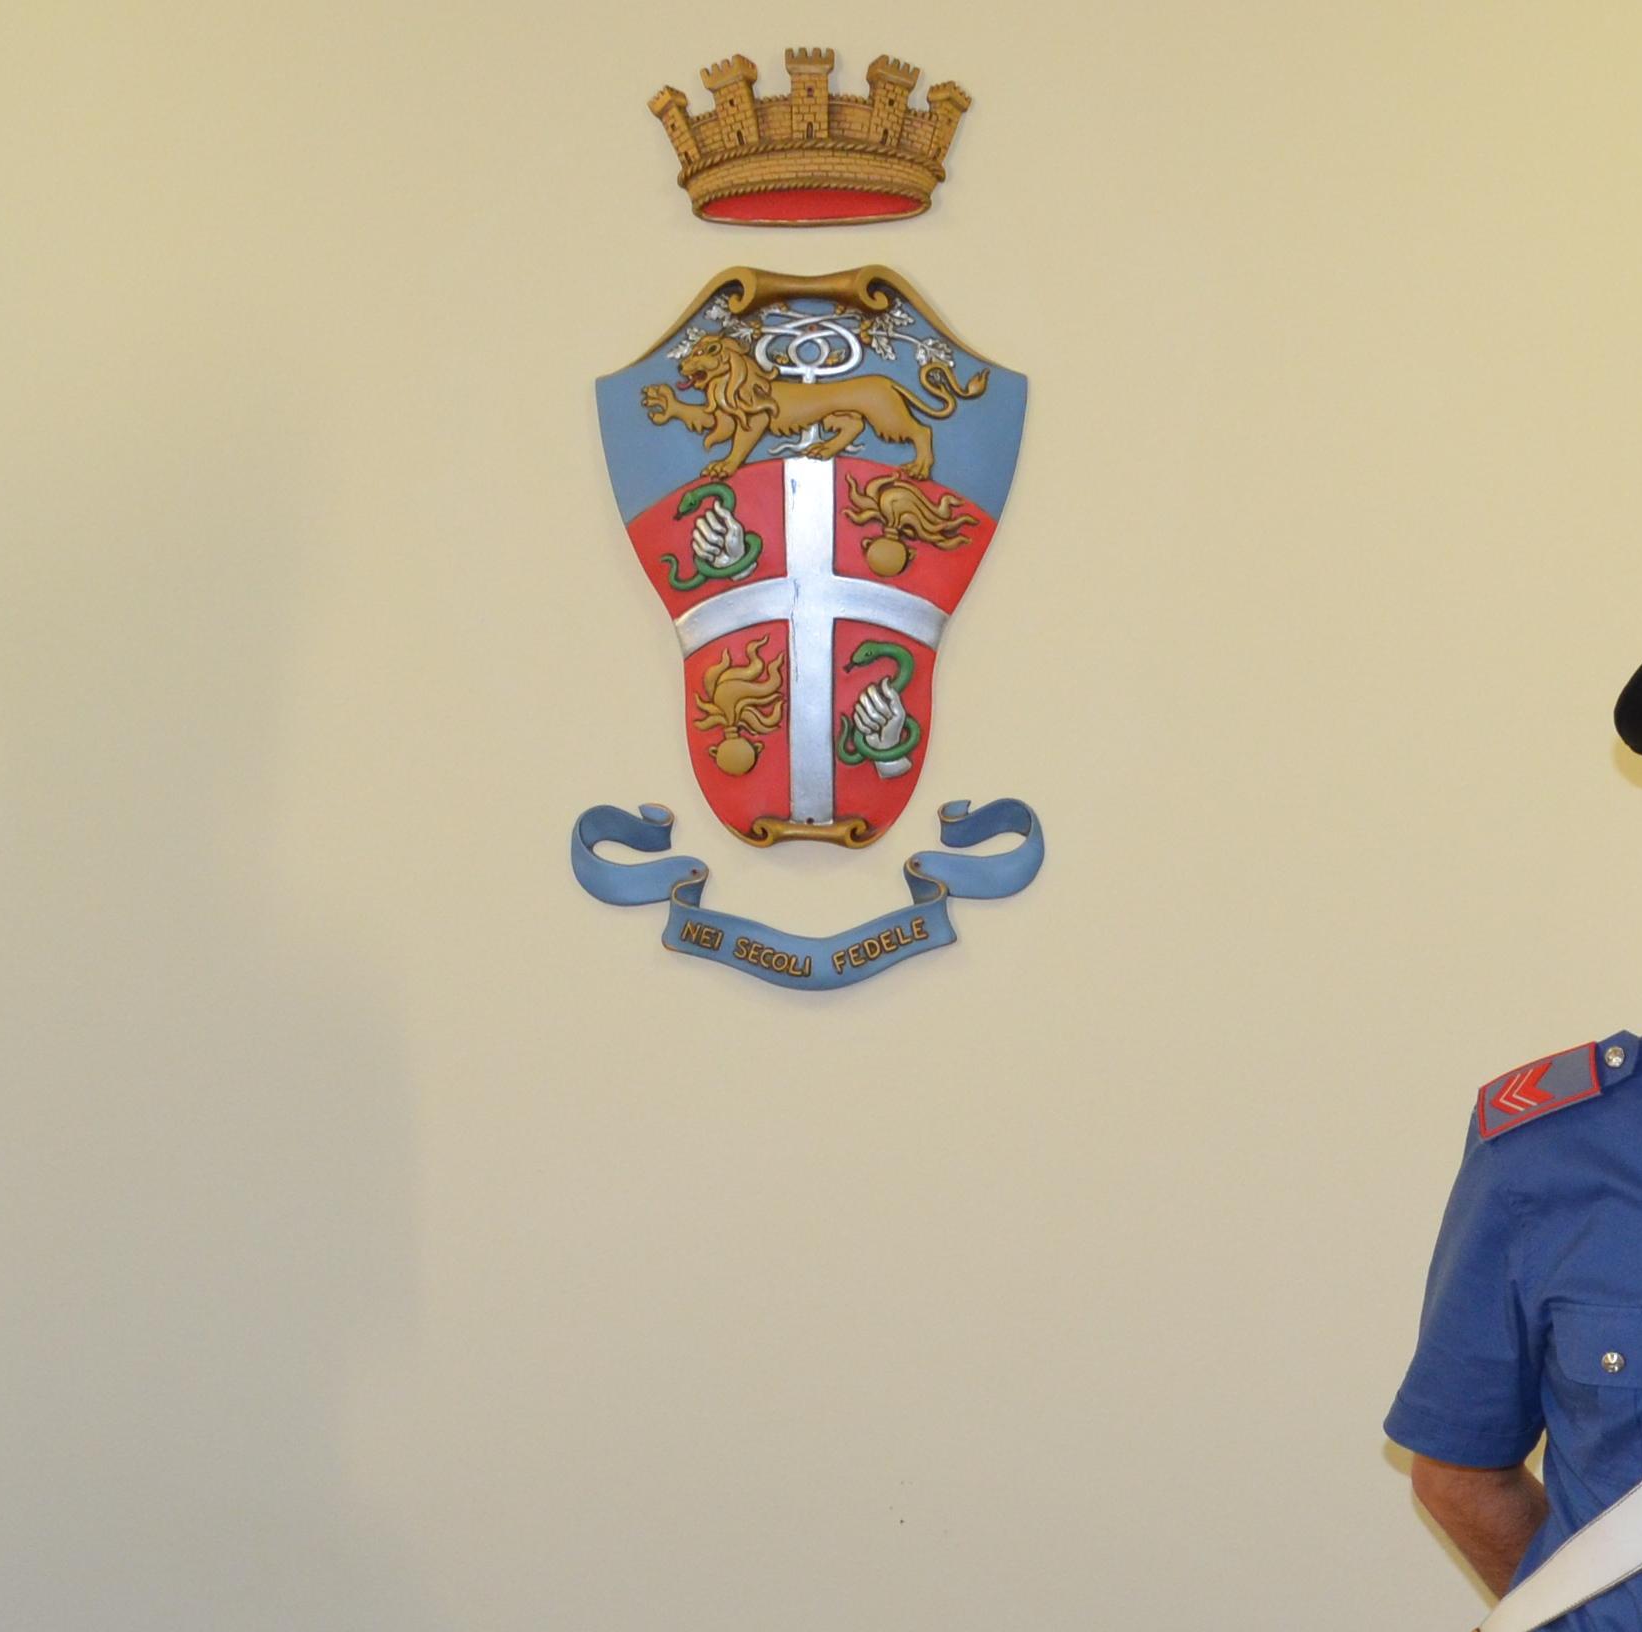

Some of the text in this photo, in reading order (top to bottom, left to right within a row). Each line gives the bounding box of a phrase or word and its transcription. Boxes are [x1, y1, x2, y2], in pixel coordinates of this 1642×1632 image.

[681, 917, 928, 977] NEI SECOLI FEDELE
